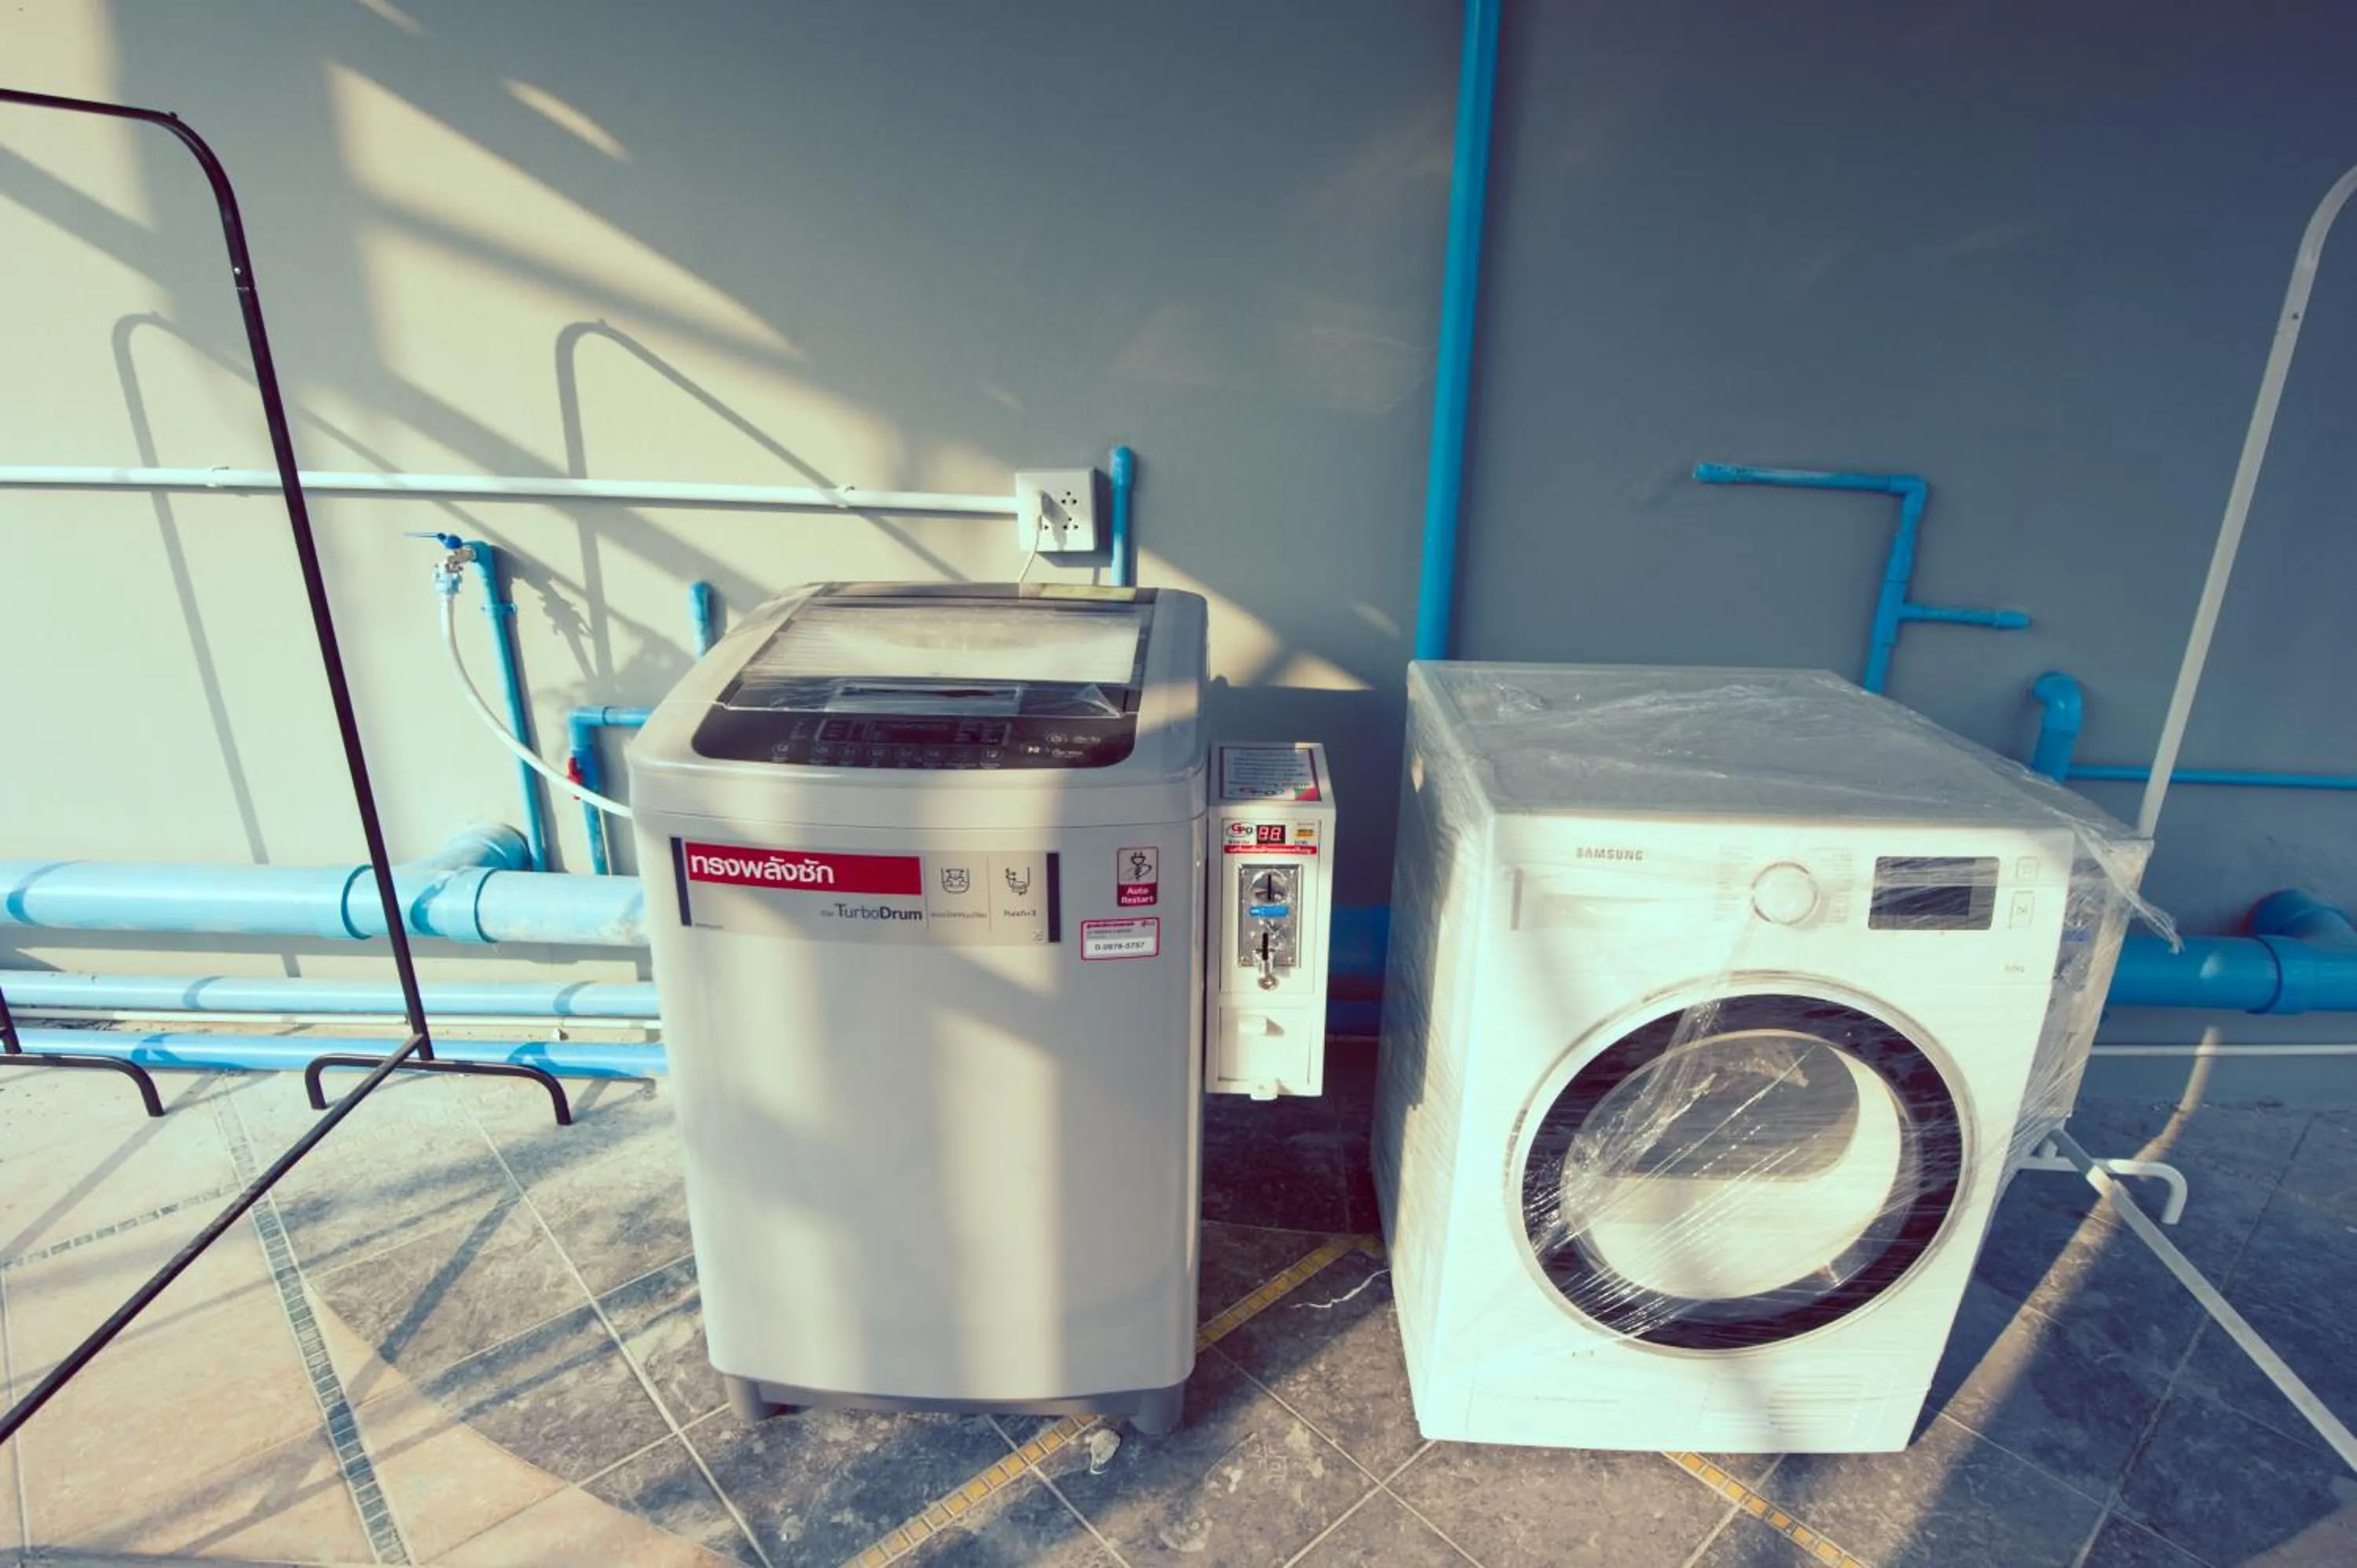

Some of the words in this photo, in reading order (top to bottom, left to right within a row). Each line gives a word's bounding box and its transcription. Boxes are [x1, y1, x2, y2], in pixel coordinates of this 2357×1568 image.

[1576, 847, 1644, 861] SAMSUNG
[691, 854, 834, 884] ทรงพลังซัก
[1121, 896, 1153, 905] Restart
[834, 903, 922, 920] TurboDrum
